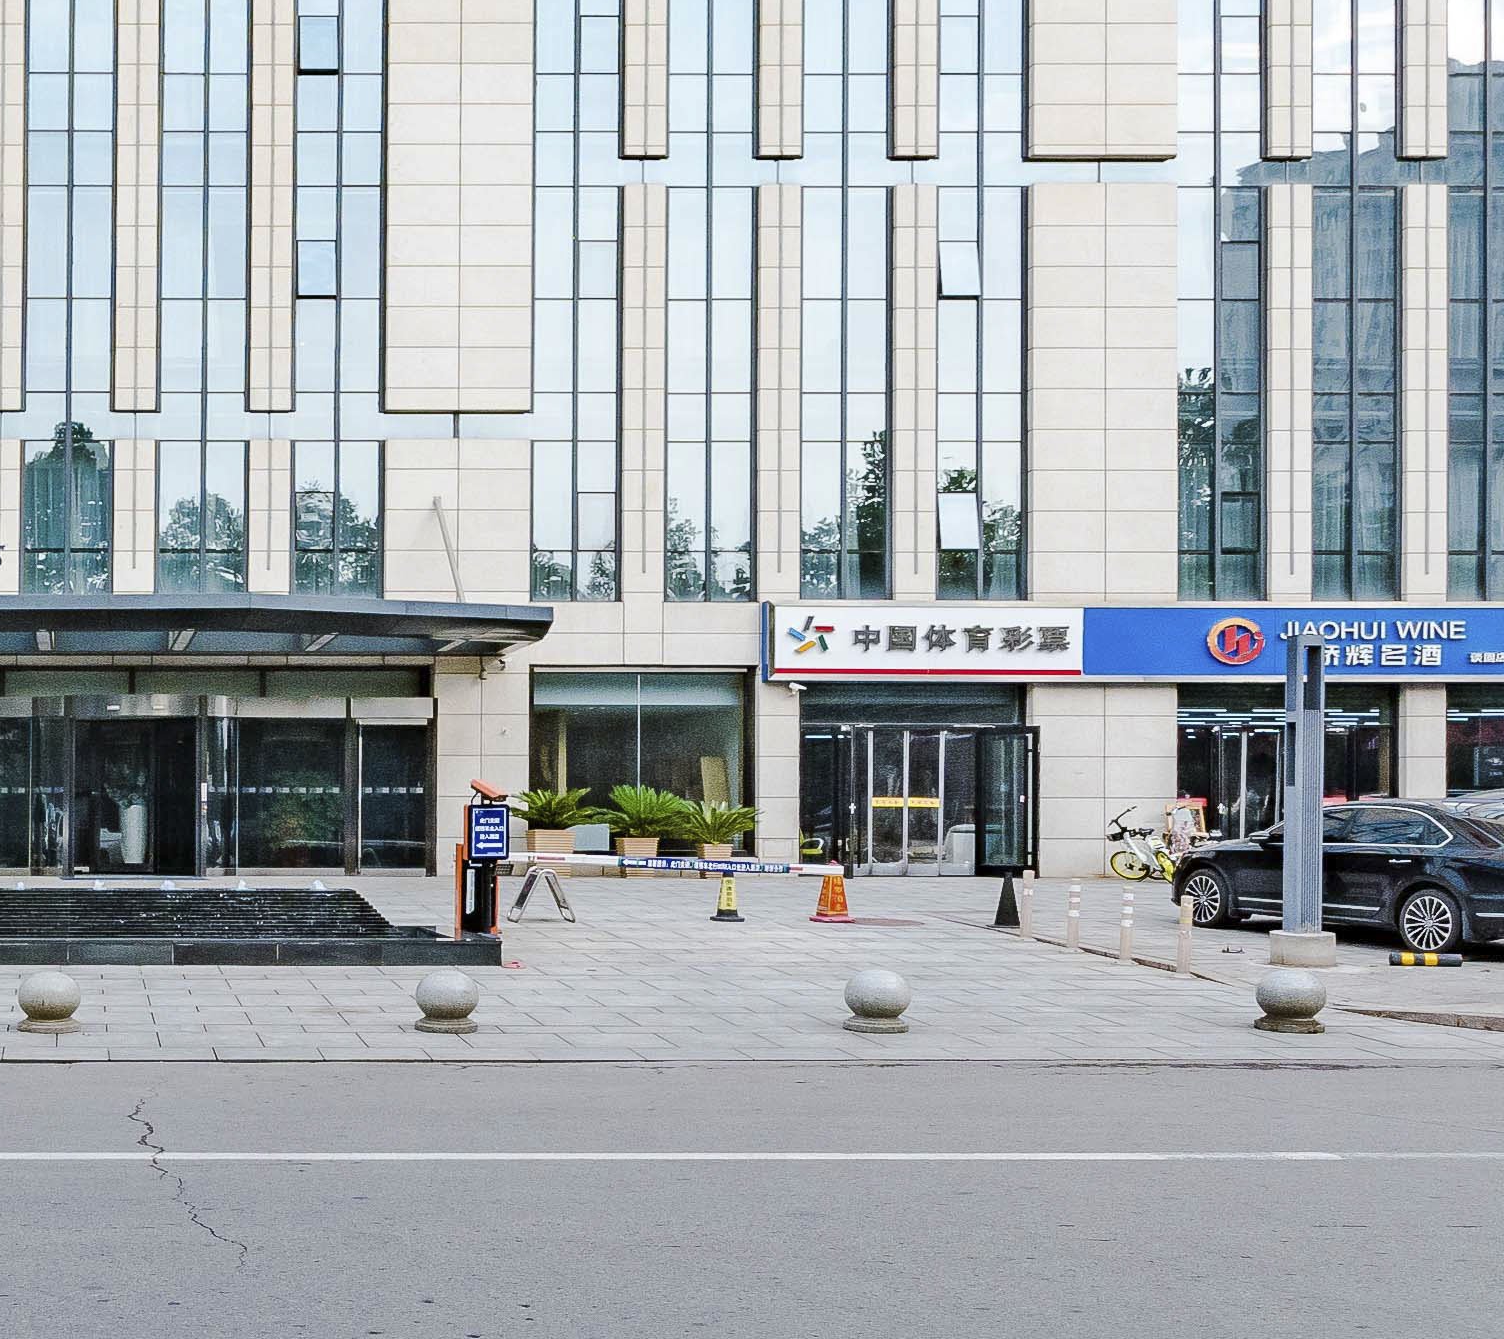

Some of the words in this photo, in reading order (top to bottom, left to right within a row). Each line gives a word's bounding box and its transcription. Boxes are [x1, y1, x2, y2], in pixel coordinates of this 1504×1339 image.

[852, 623, 1071, 653] 中国体育彩票
[1279, 620, 1386, 640] JIAOHUI
[1396, 620, 1467, 640] WINE
